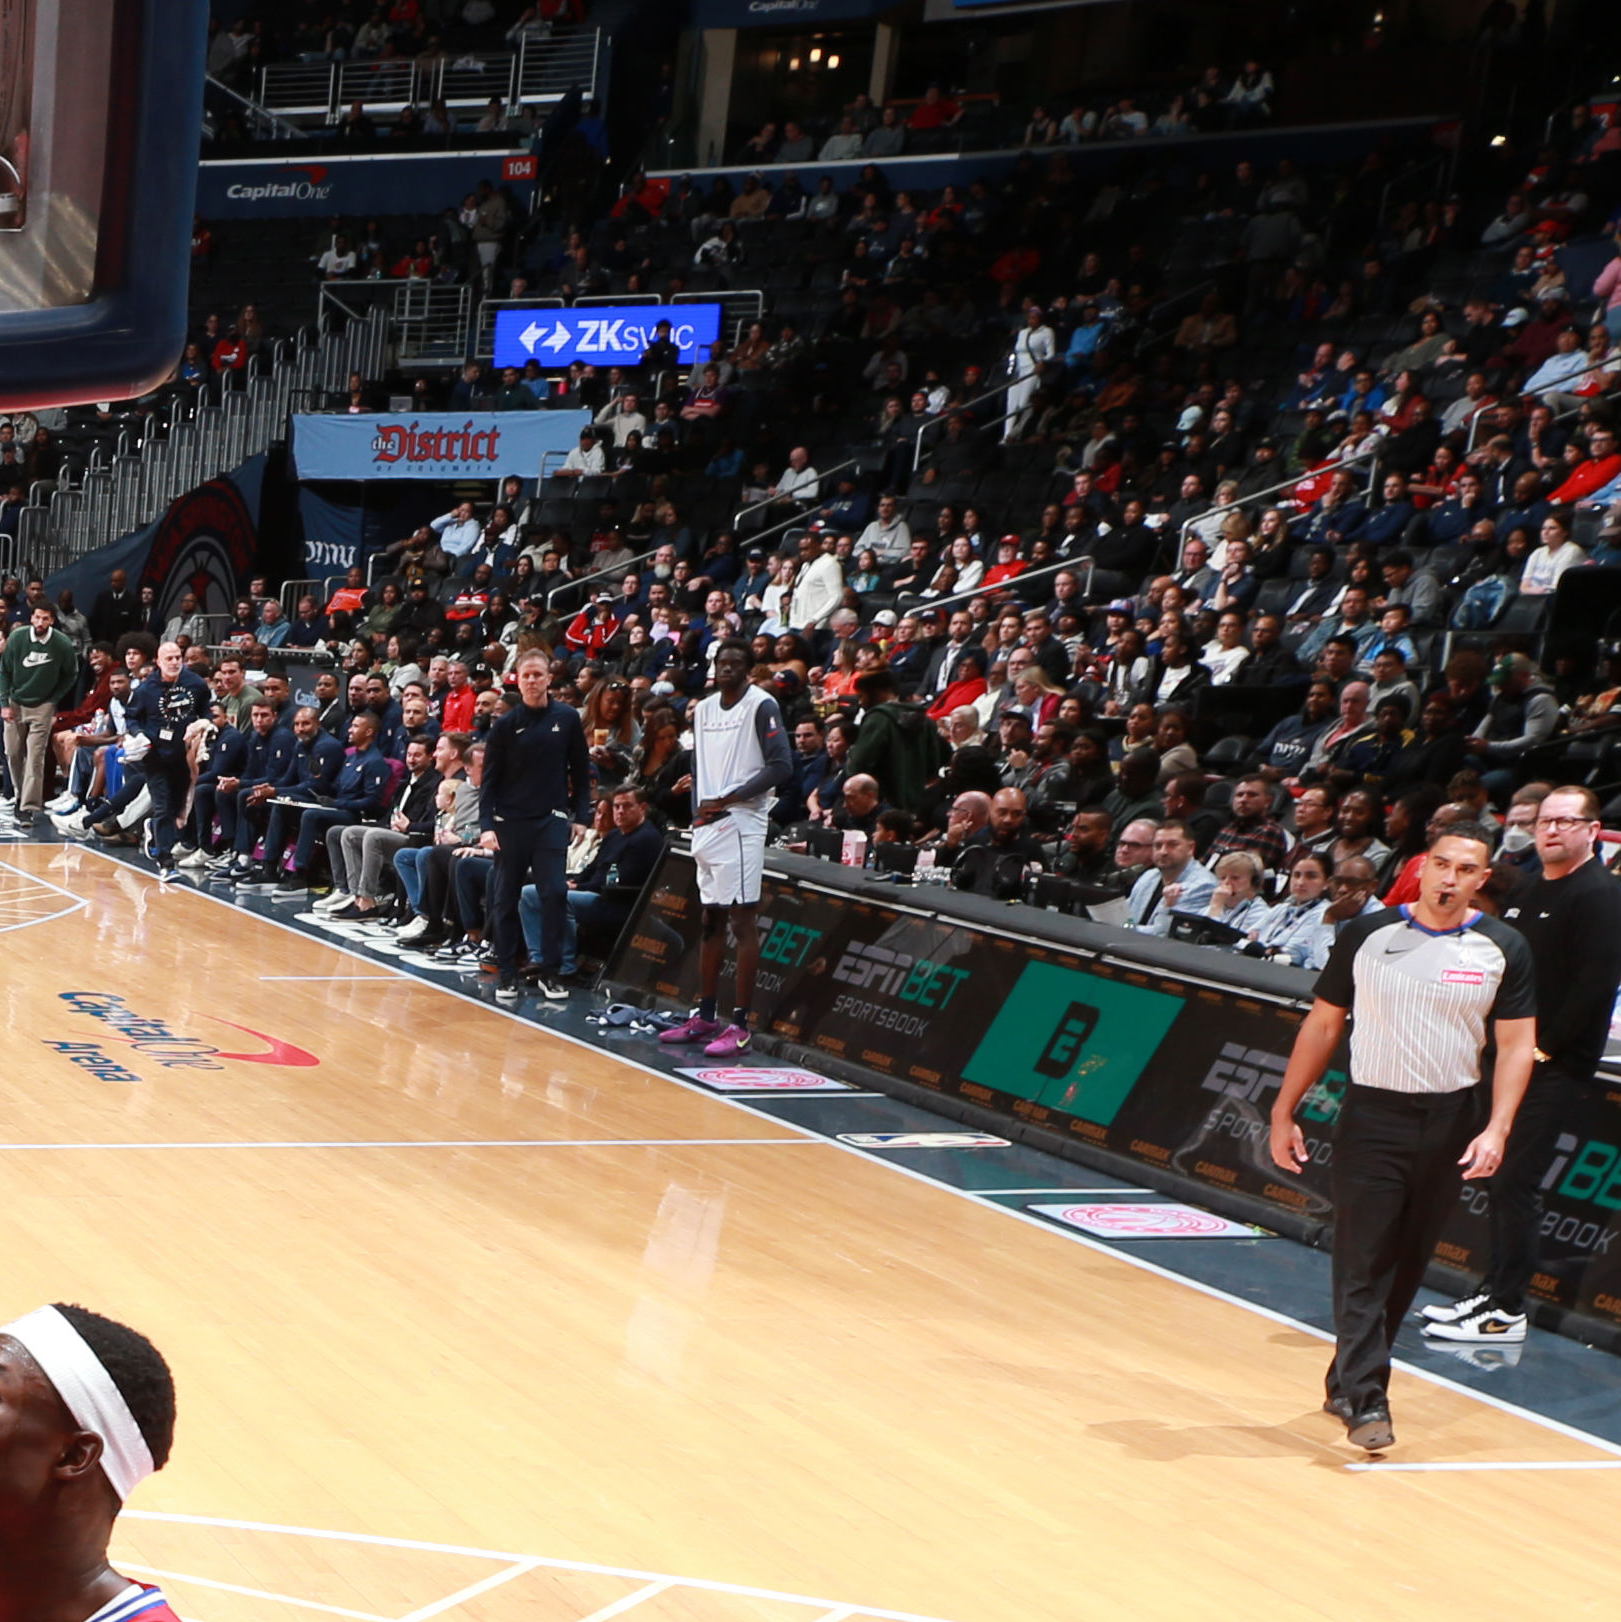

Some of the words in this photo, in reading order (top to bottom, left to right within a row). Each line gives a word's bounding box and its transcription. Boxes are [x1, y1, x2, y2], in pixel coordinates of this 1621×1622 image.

[507, 161, 532, 176] 104
[371, 432, 396, 453] the
[373, 419, 501, 464] District
[375, 464, 395, 473] OF
[406, 464, 494, 473] COLUMBIA
[760, 920, 823, 969] BET
[831, 938, 914, 998] ESPN
[899, 958, 971, 1011] BET
[1442, 971, 1485, 984] Emirates
[831, 994, 933, 1039] SPORTSBOOK
[43, 1038, 143, 1084] Arena
[1199, 1040, 1290, 1105] ESP
